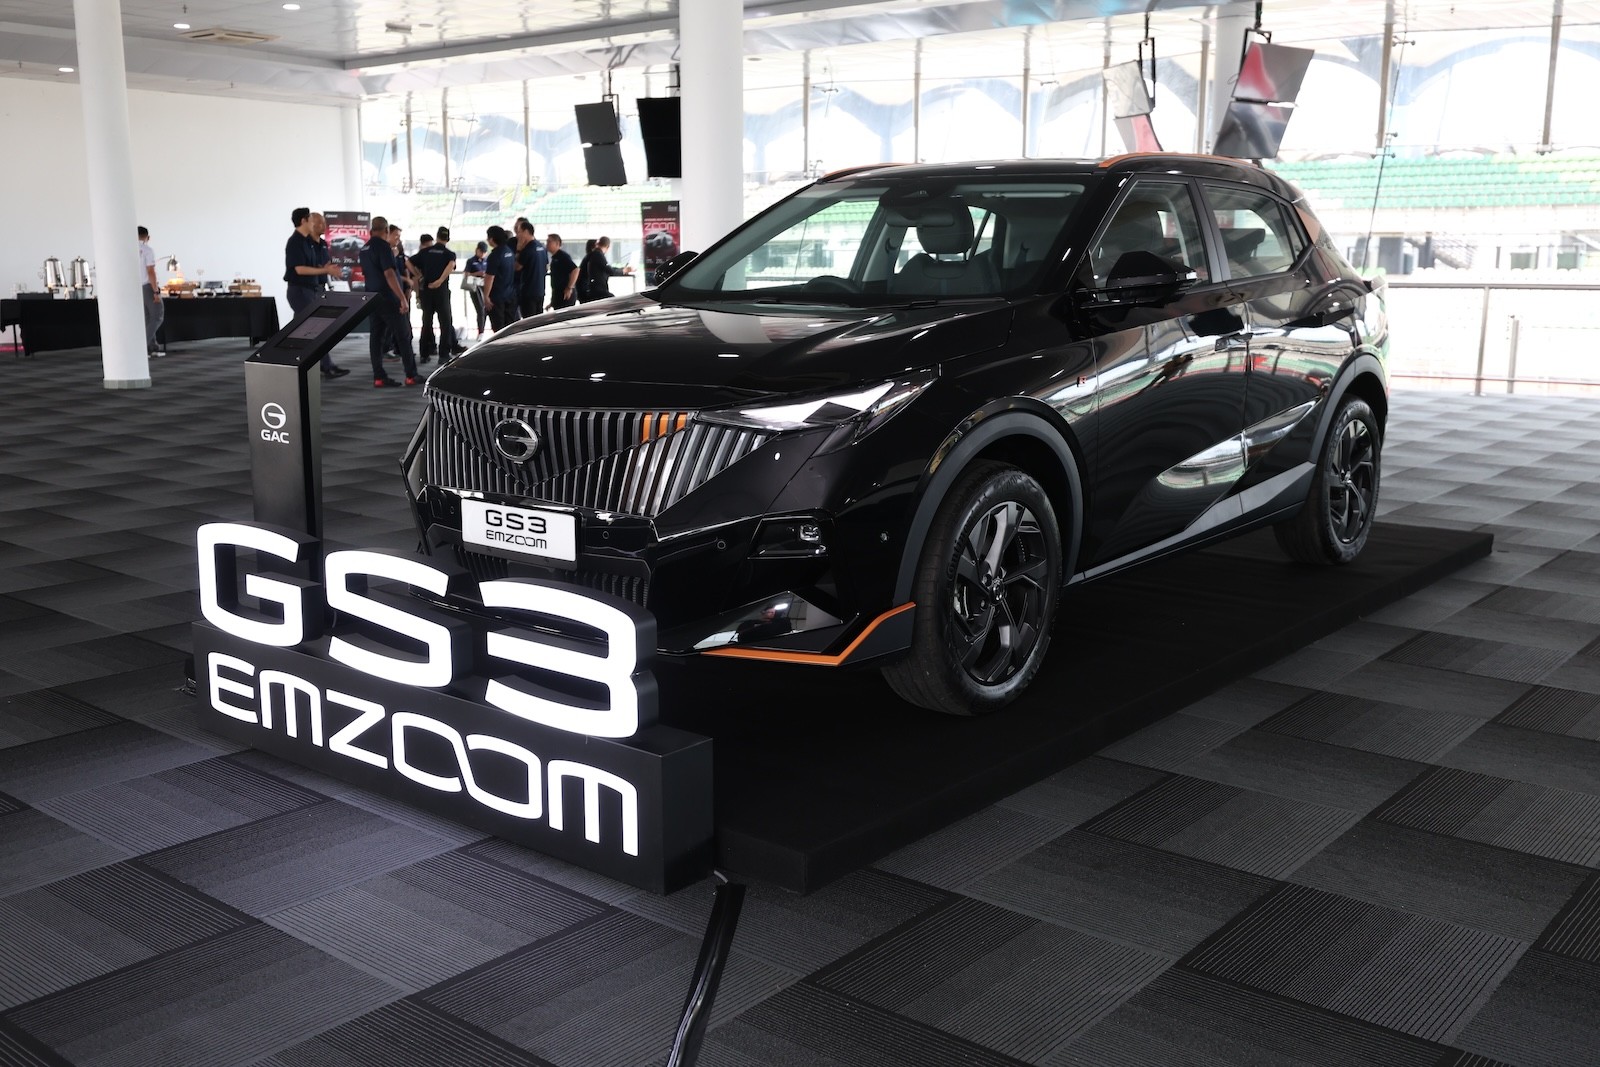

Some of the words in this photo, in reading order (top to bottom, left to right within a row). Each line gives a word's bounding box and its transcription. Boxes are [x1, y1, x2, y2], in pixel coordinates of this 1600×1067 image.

[260, 429, 290, 444] GAC
[485, 509, 547, 534] GS3
[485, 529, 547, 550] EMZOOM
[196, 522, 639, 738] GS3
[207, 652, 639, 857] EMZOOM
